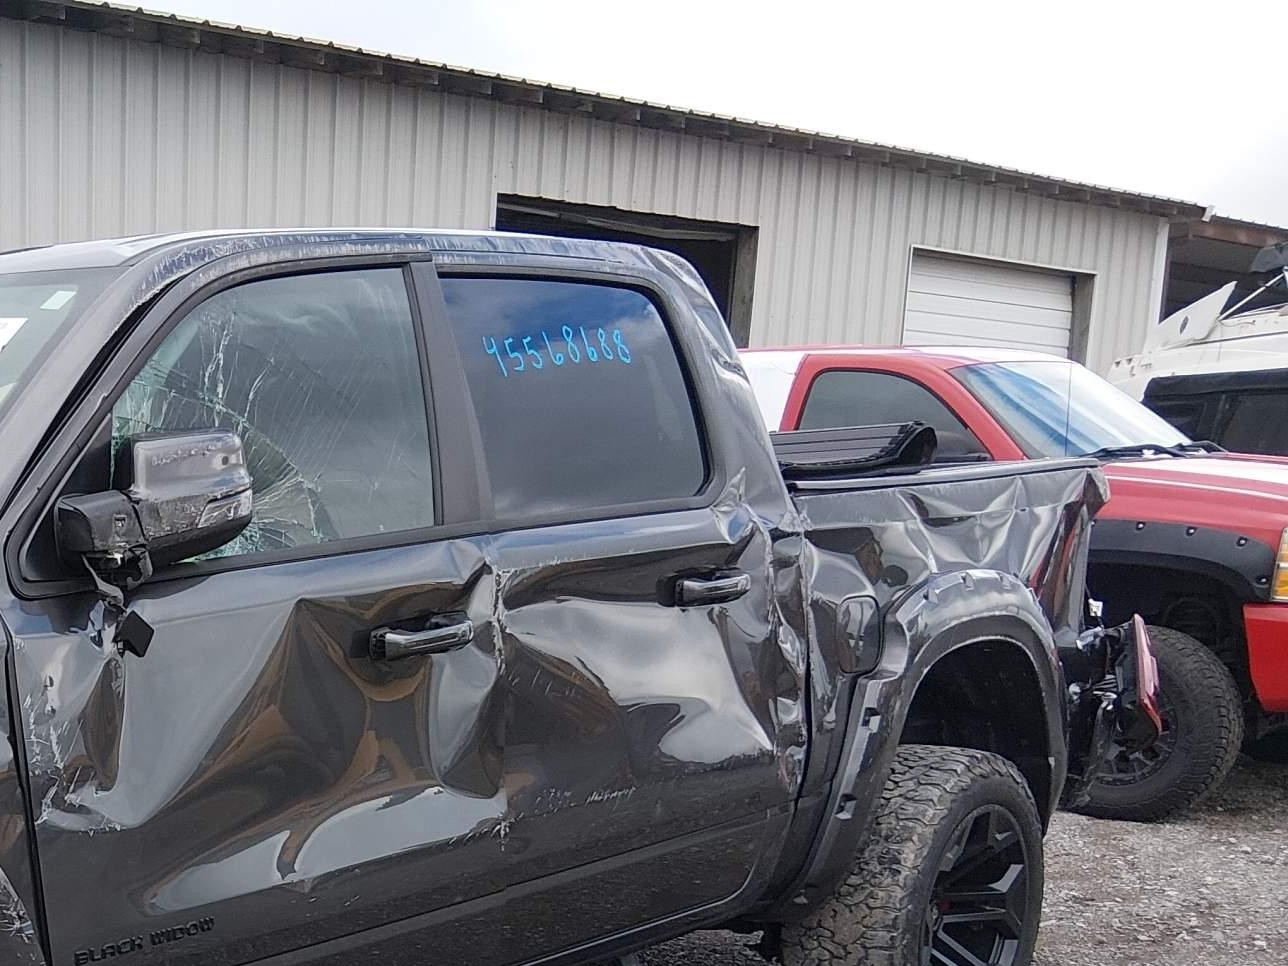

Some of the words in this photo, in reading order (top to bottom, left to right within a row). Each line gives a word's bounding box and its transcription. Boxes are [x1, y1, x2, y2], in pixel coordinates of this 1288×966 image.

[482, 325, 632, 376] 45568688
[73, 935, 143, 966] BLACK
[149, 917, 215, 946] WIDOW
